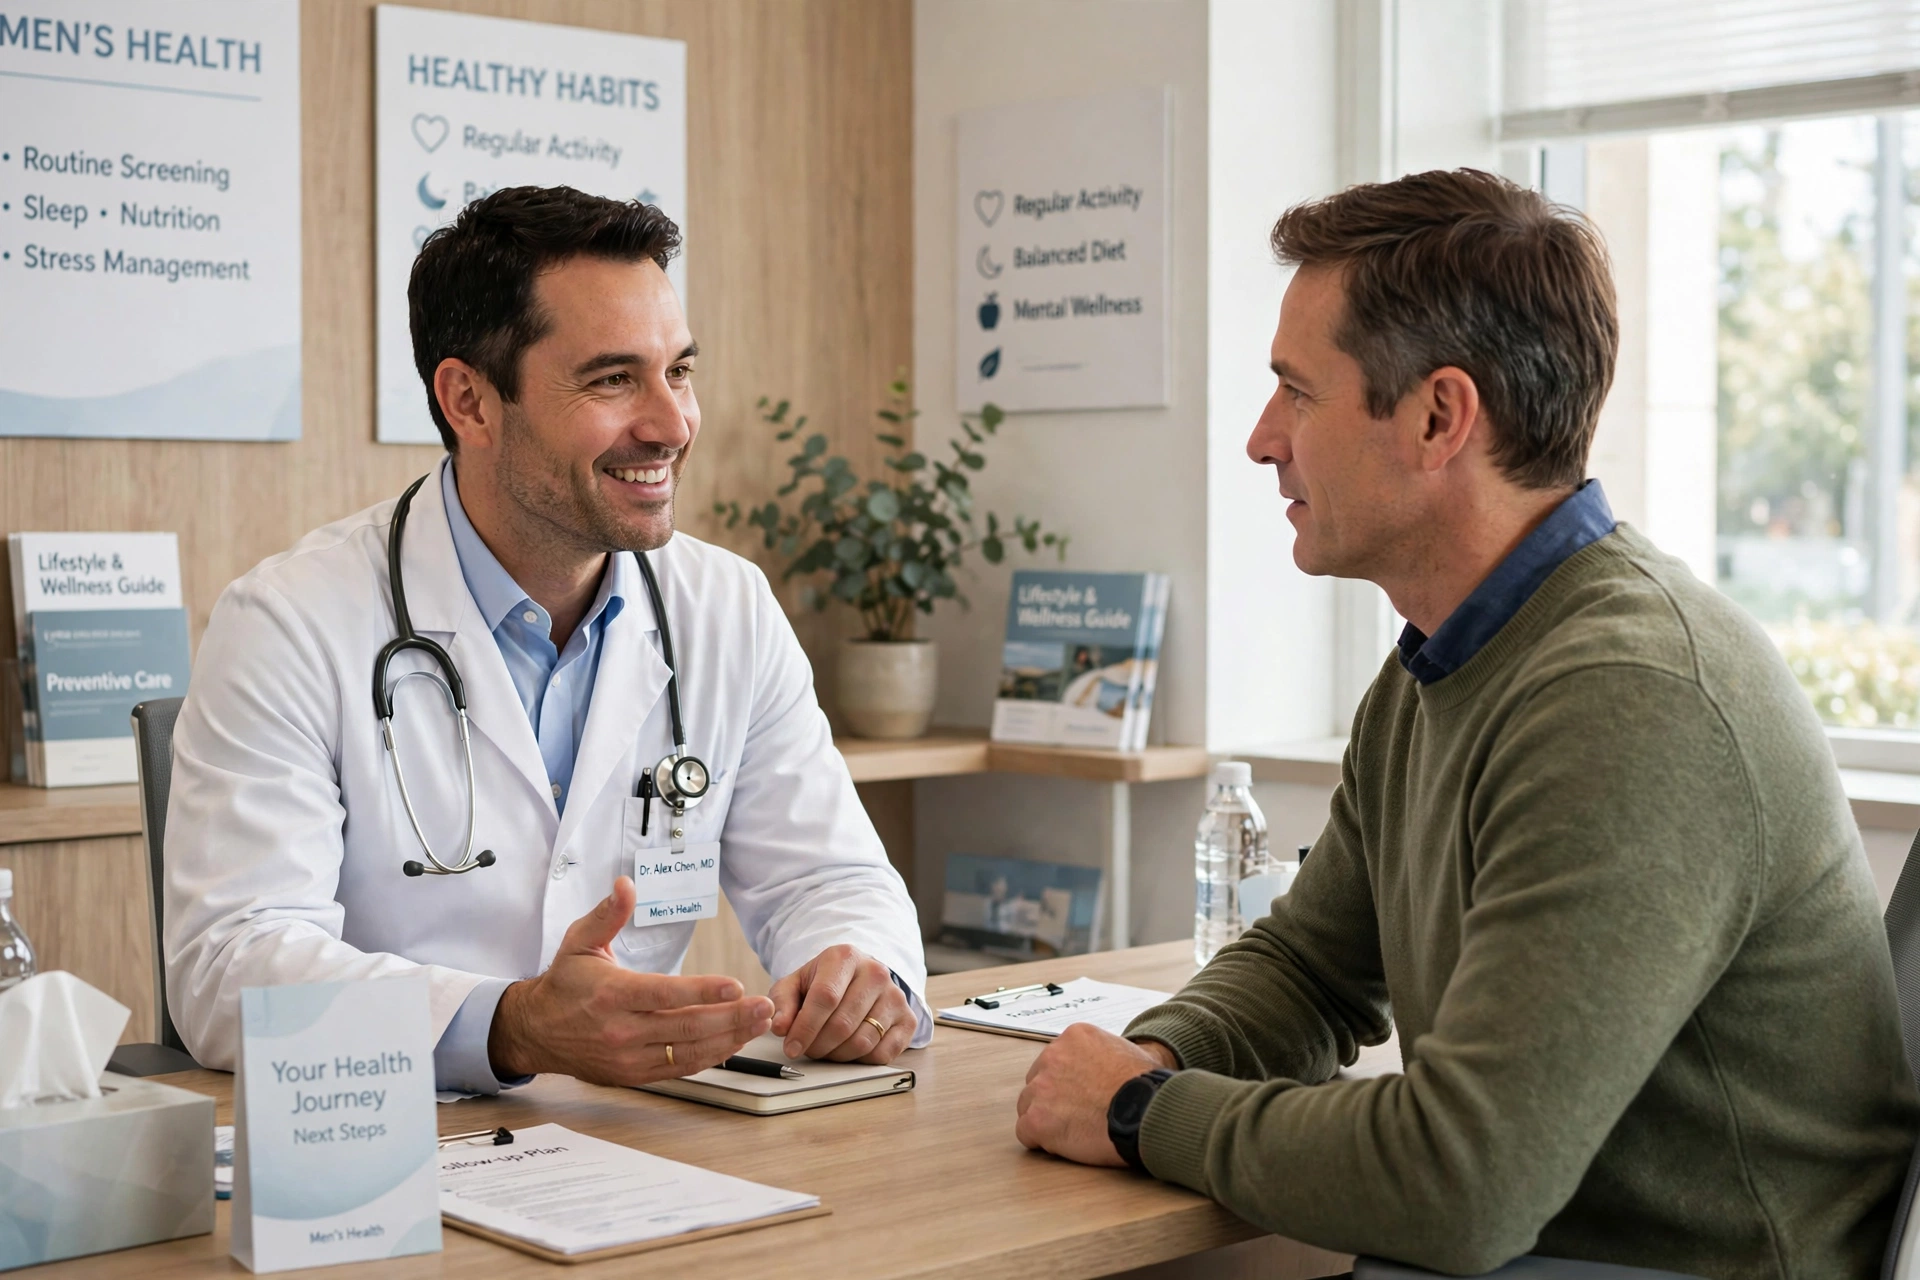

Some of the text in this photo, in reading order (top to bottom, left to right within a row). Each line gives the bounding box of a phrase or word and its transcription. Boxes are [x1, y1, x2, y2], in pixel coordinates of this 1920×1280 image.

[0, 13, 261, 74] MEN'S HEALTH
[408, 54, 660, 111] HEALTHY HABITS
[463, 125, 622, 169] Regular Activity
[23, 146, 230, 191] Routine Screening
[24, 195, 220, 231] Sleep Nutrition
[1013, 184, 1143, 220] Regular Activity
[24, 244, 250, 282] Stress Management
[1013, 239, 1126, 269] Balanced Diet
[1013, 292, 1143, 321] Mental Wellness
[38, 553, 123, 575] Lifestyle &
[40, 575, 166, 595] Wellness Guide
[1018, 584, 1098, 607] Lifestyle &
[1017, 606, 1132, 628] Wellness Guide
[46, 670, 172, 692] Preventive Care
[640, 858, 715, 876] Dr. Alex Chen, MD
[649, 902, 702, 917] Men's Health
[272, 1051, 412, 1083] Your Health
[291, 1089, 386, 1114] Journey
[293, 1122, 387, 1145] Next Steps
[441, 1146, 569, 1171] ollow-up Plan
[309, 1224, 385, 1244] Men's Health
